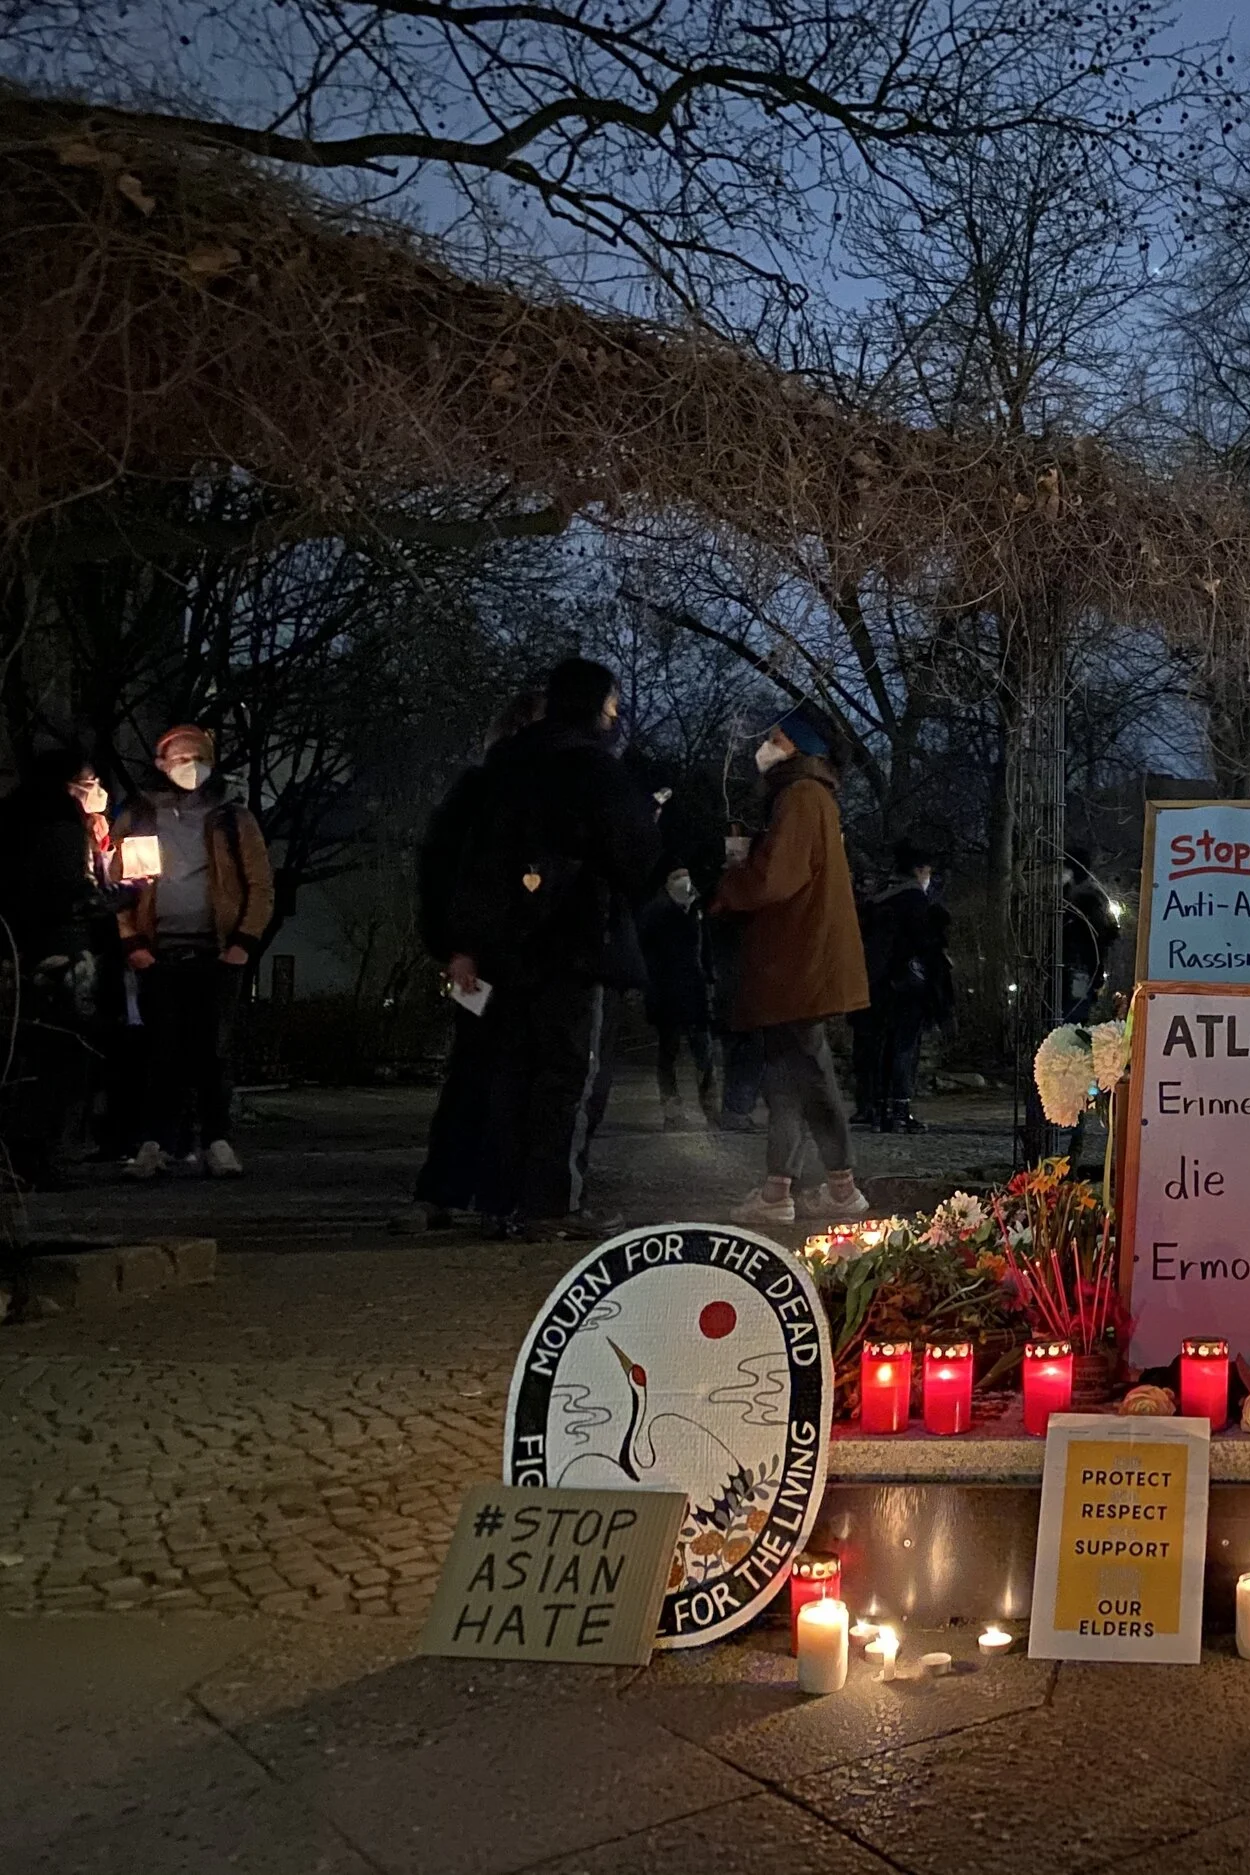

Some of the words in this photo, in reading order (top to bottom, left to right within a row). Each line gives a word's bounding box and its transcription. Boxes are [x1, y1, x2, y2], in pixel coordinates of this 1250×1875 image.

[1164, 1156, 1225, 1199] die
[530, 1261, 612, 1376] MOURN
[625, 1233, 684, 1272] FOR
[708, 1236, 770, 1281] THE
[765, 1274, 820, 1367] DEAD
[1082, 1470, 1172, 1487] PROTECT
[473, 1504, 638, 1551] #STOP
[674, 1582, 741, 1633] FOR
[734, 1530, 791, 1590] THE
[773, 1420, 816, 1532] LIVING
[1082, 1504, 1168, 1521] RESPECT
[1075, 1540, 1170, 1557] SUPPORT
[467, 1552, 626, 1595] ASIAN
[452, 1603, 616, 1648] HATE
[1079, 1620, 1155, 1638] ELDERS
[1098, 1599, 1142, 1616] OUR
